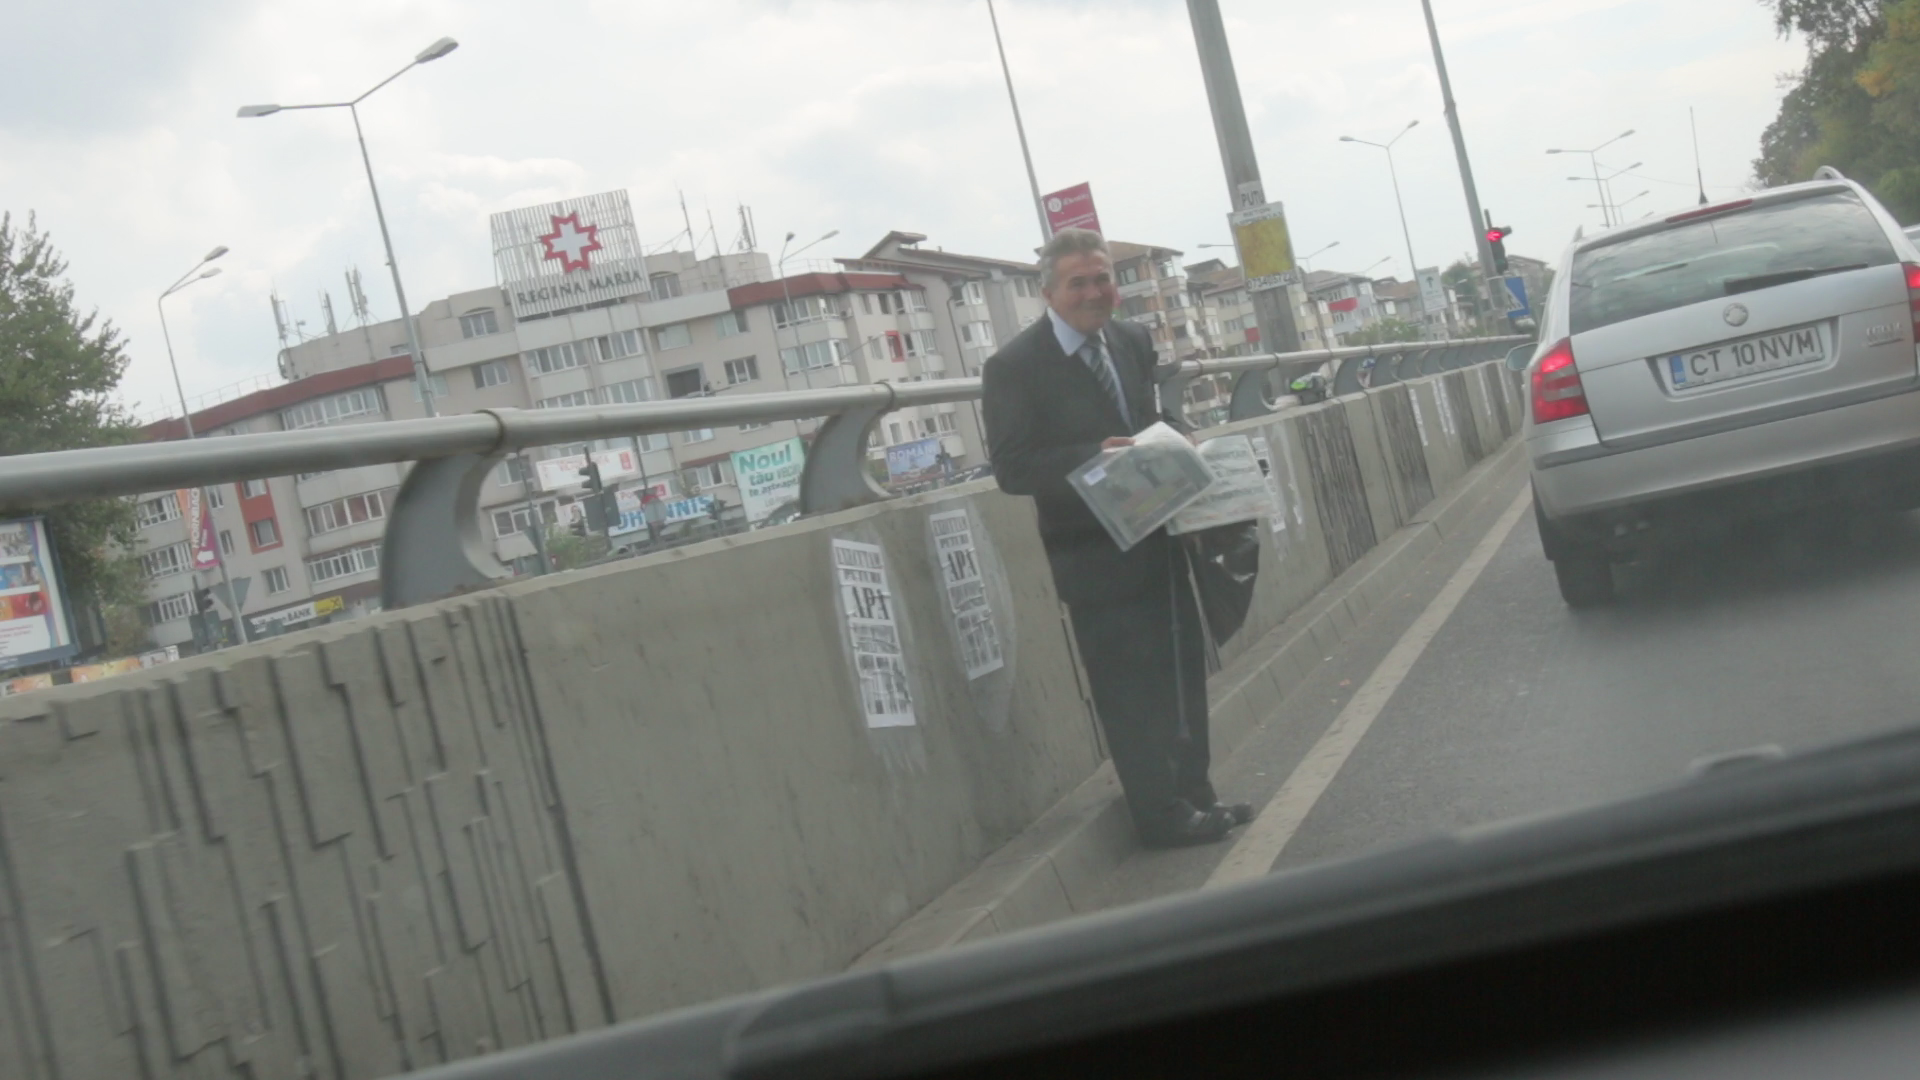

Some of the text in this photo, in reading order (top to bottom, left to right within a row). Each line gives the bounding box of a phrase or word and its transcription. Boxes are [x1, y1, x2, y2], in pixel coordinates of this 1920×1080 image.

[517, 270, 644, 304] REGINA MARIA
[1690, 330, 1815, 376] CT 10 NVM
[738, 444, 792, 474] Noul
[947, 549, 978, 583] APA
[848, 585, 890, 620] APA
